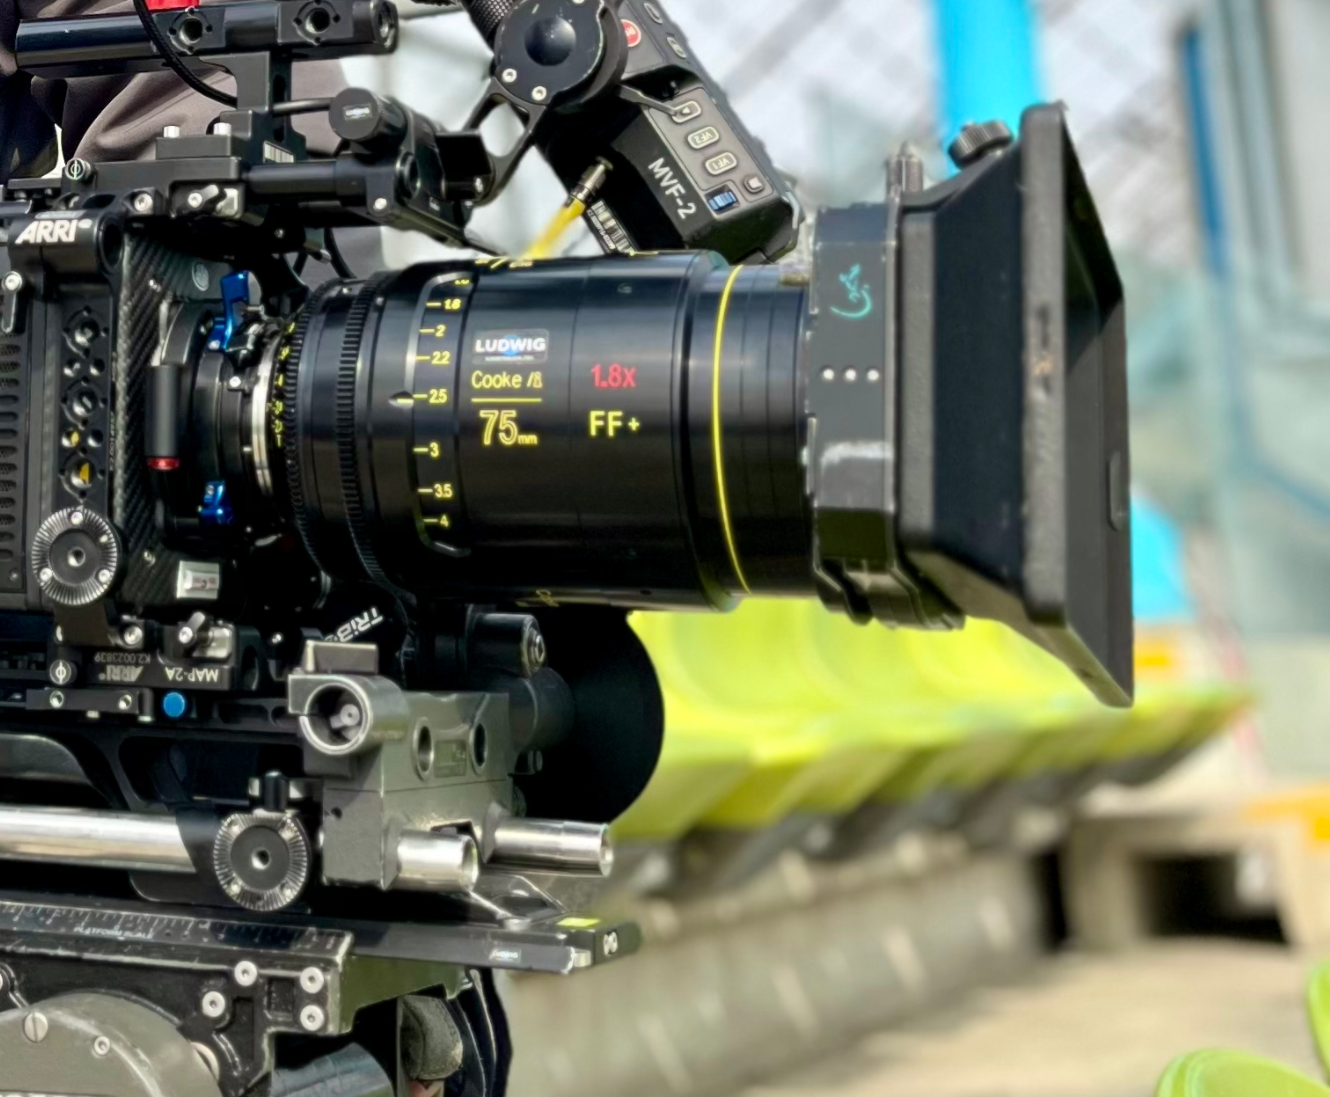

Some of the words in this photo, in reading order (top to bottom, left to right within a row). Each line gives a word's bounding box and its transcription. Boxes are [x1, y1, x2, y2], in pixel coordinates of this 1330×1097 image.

[694, 131, 714, 145] VF2
[711, 157, 731, 171] VF1
[648, 157, 697, 220] MVF-2
[15, 218, 79, 244] ARRI
[434, 324, 446, 337] 2
[475, 337, 546, 353] LUDWIG
[471, 369, 522, 389] Cooke
[591, 362, 637, 388] 1.8x
[429, 442, 440, 458] 3
[106, 664, 144, 682] ARRI
[164, 666, 219, 683] MAP-2A
